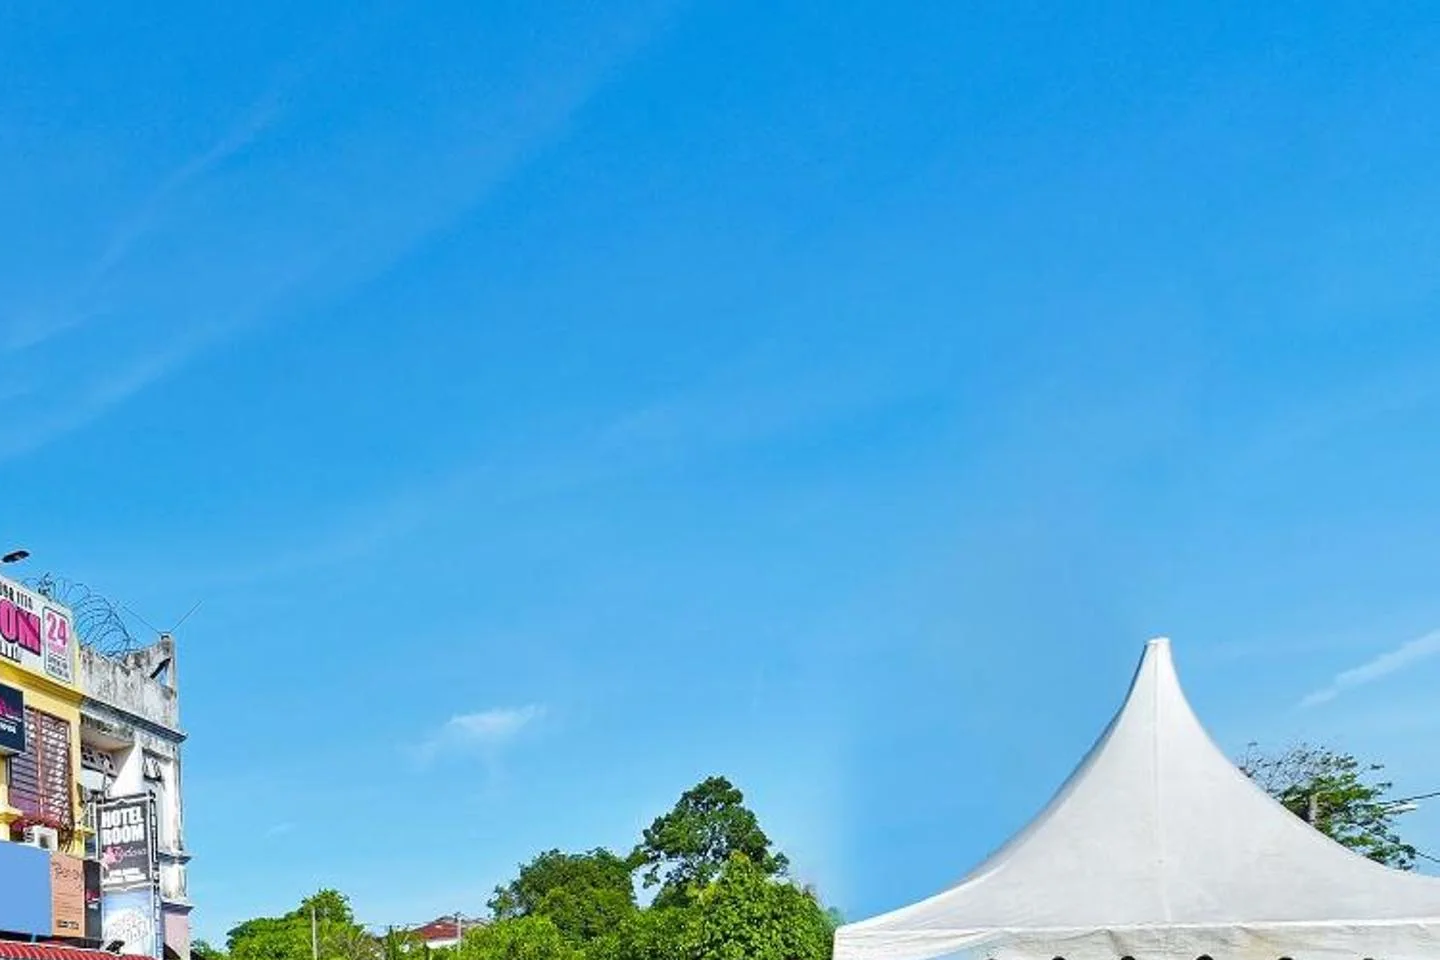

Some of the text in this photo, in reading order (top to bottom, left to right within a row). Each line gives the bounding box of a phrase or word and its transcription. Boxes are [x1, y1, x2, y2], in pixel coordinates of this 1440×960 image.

[46, 611, 68, 646] 24
[101, 805, 144, 829] HOTEL
[101, 822, 145, 846] ROOM
